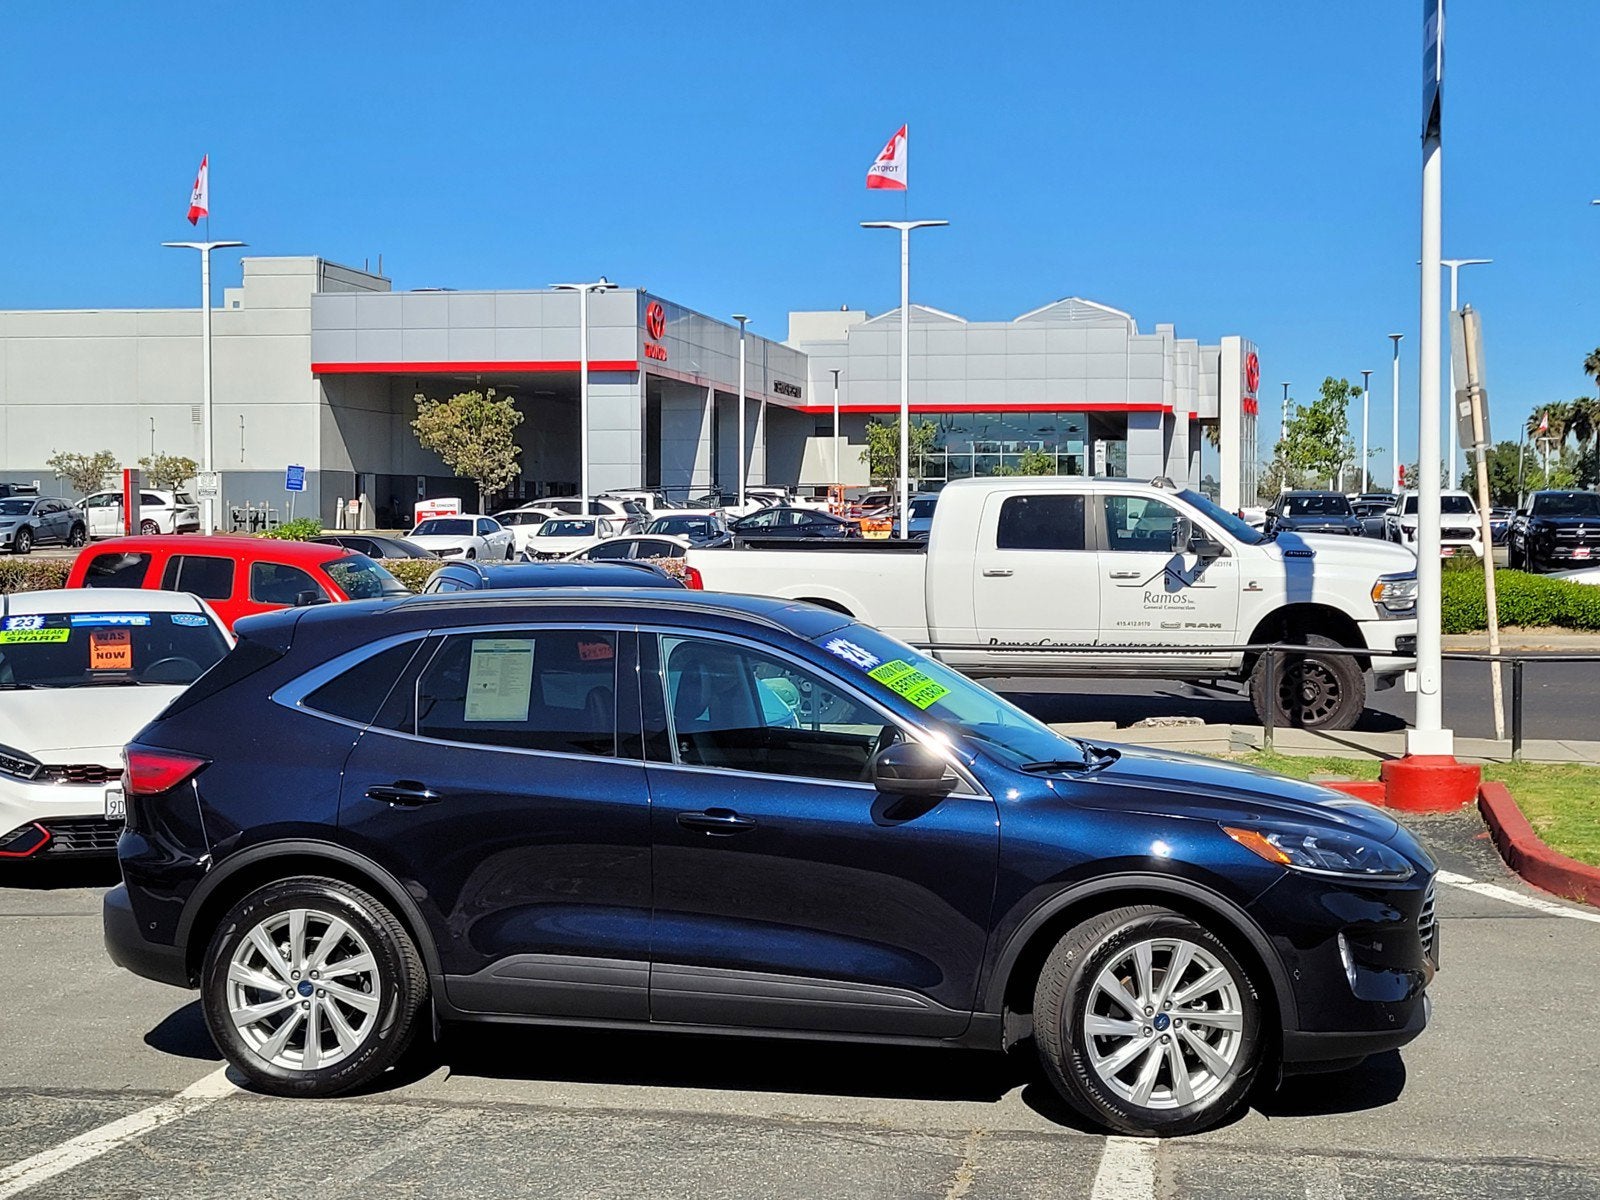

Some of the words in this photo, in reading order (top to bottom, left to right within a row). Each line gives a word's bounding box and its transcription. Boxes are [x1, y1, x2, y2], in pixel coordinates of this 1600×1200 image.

[1143, 591, 1188, 604] Ramos
[13, 619, 35, 628] 23
[96, 631, 126, 641] WAS
[96, 651, 126, 660] NOW
[910, 683, 946, 706] HYBRID
